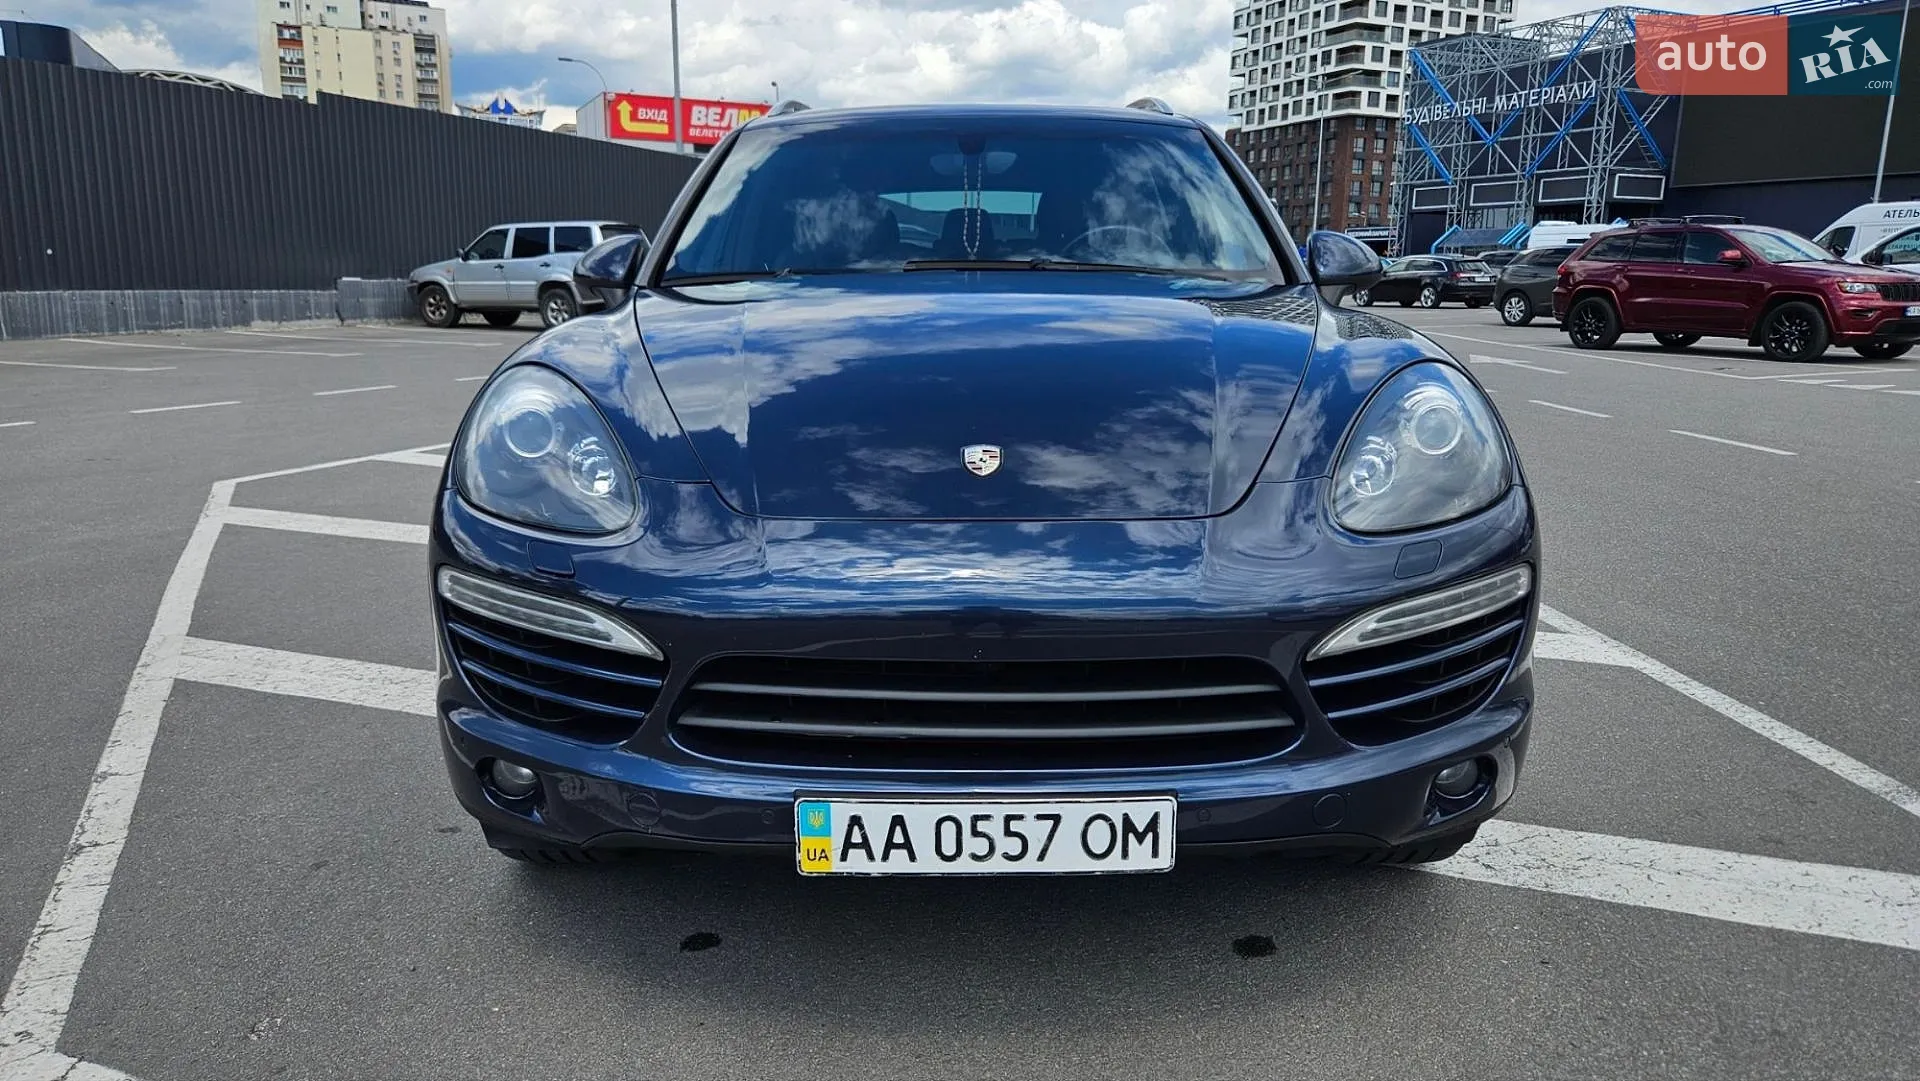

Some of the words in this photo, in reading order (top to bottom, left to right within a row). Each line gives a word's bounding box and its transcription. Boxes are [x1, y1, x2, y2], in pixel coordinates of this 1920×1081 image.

[1404, 97, 1487, 125] БУДІВЕЛЬНІ
[1493, 80, 1597, 112] МАТЕРІАЛИ
[638, 107, 668, 122] ВХІД
[689, 127, 729, 138] ВЕЛЕТЕ
[839, 814, 918, 863] AA
[934, 813, 1063, 863] 0557
[1080, 811, 1161, 861] OM
[806, 850, 830, 862] UA
